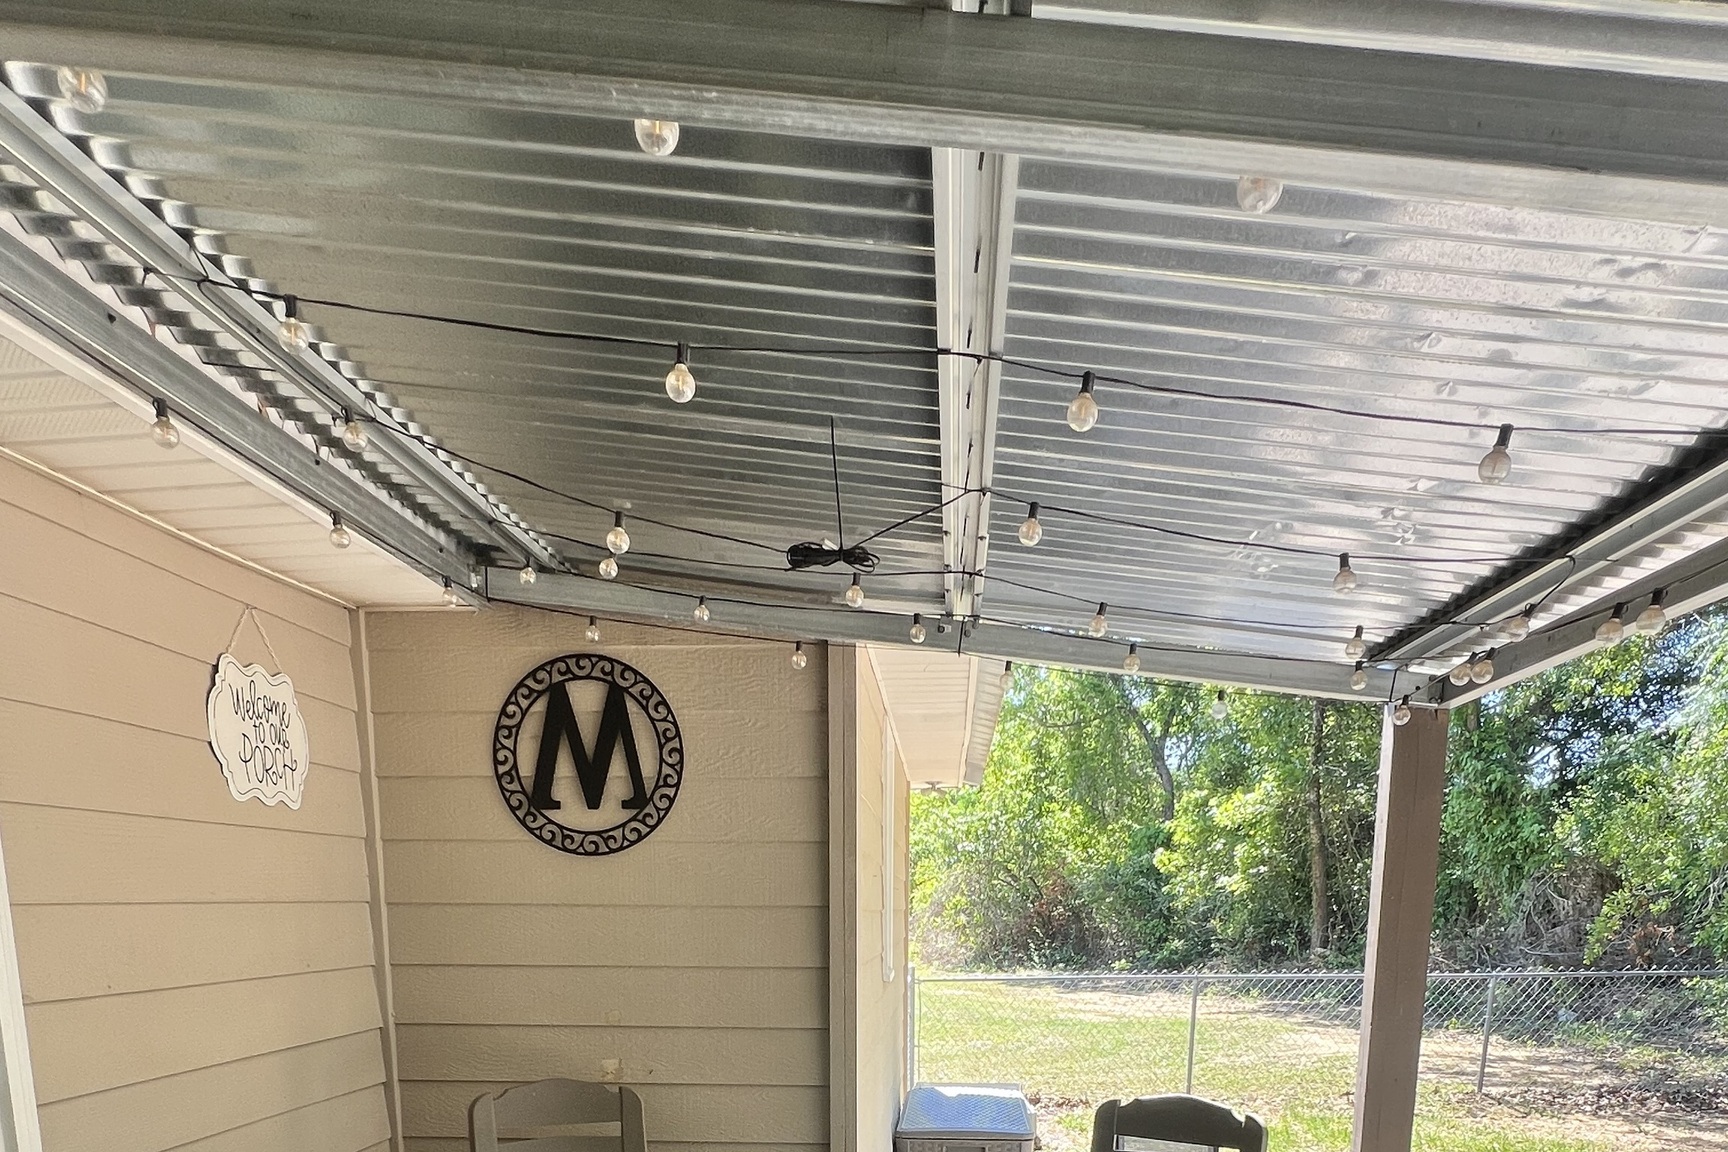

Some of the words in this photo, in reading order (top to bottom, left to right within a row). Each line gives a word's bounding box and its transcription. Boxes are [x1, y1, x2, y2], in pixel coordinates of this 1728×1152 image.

[228, 679, 291, 729] Welcome
[252, 720, 266, 744] to
[529, 681, 651, 811] M
[238, 732, 298, 791] PORCH
